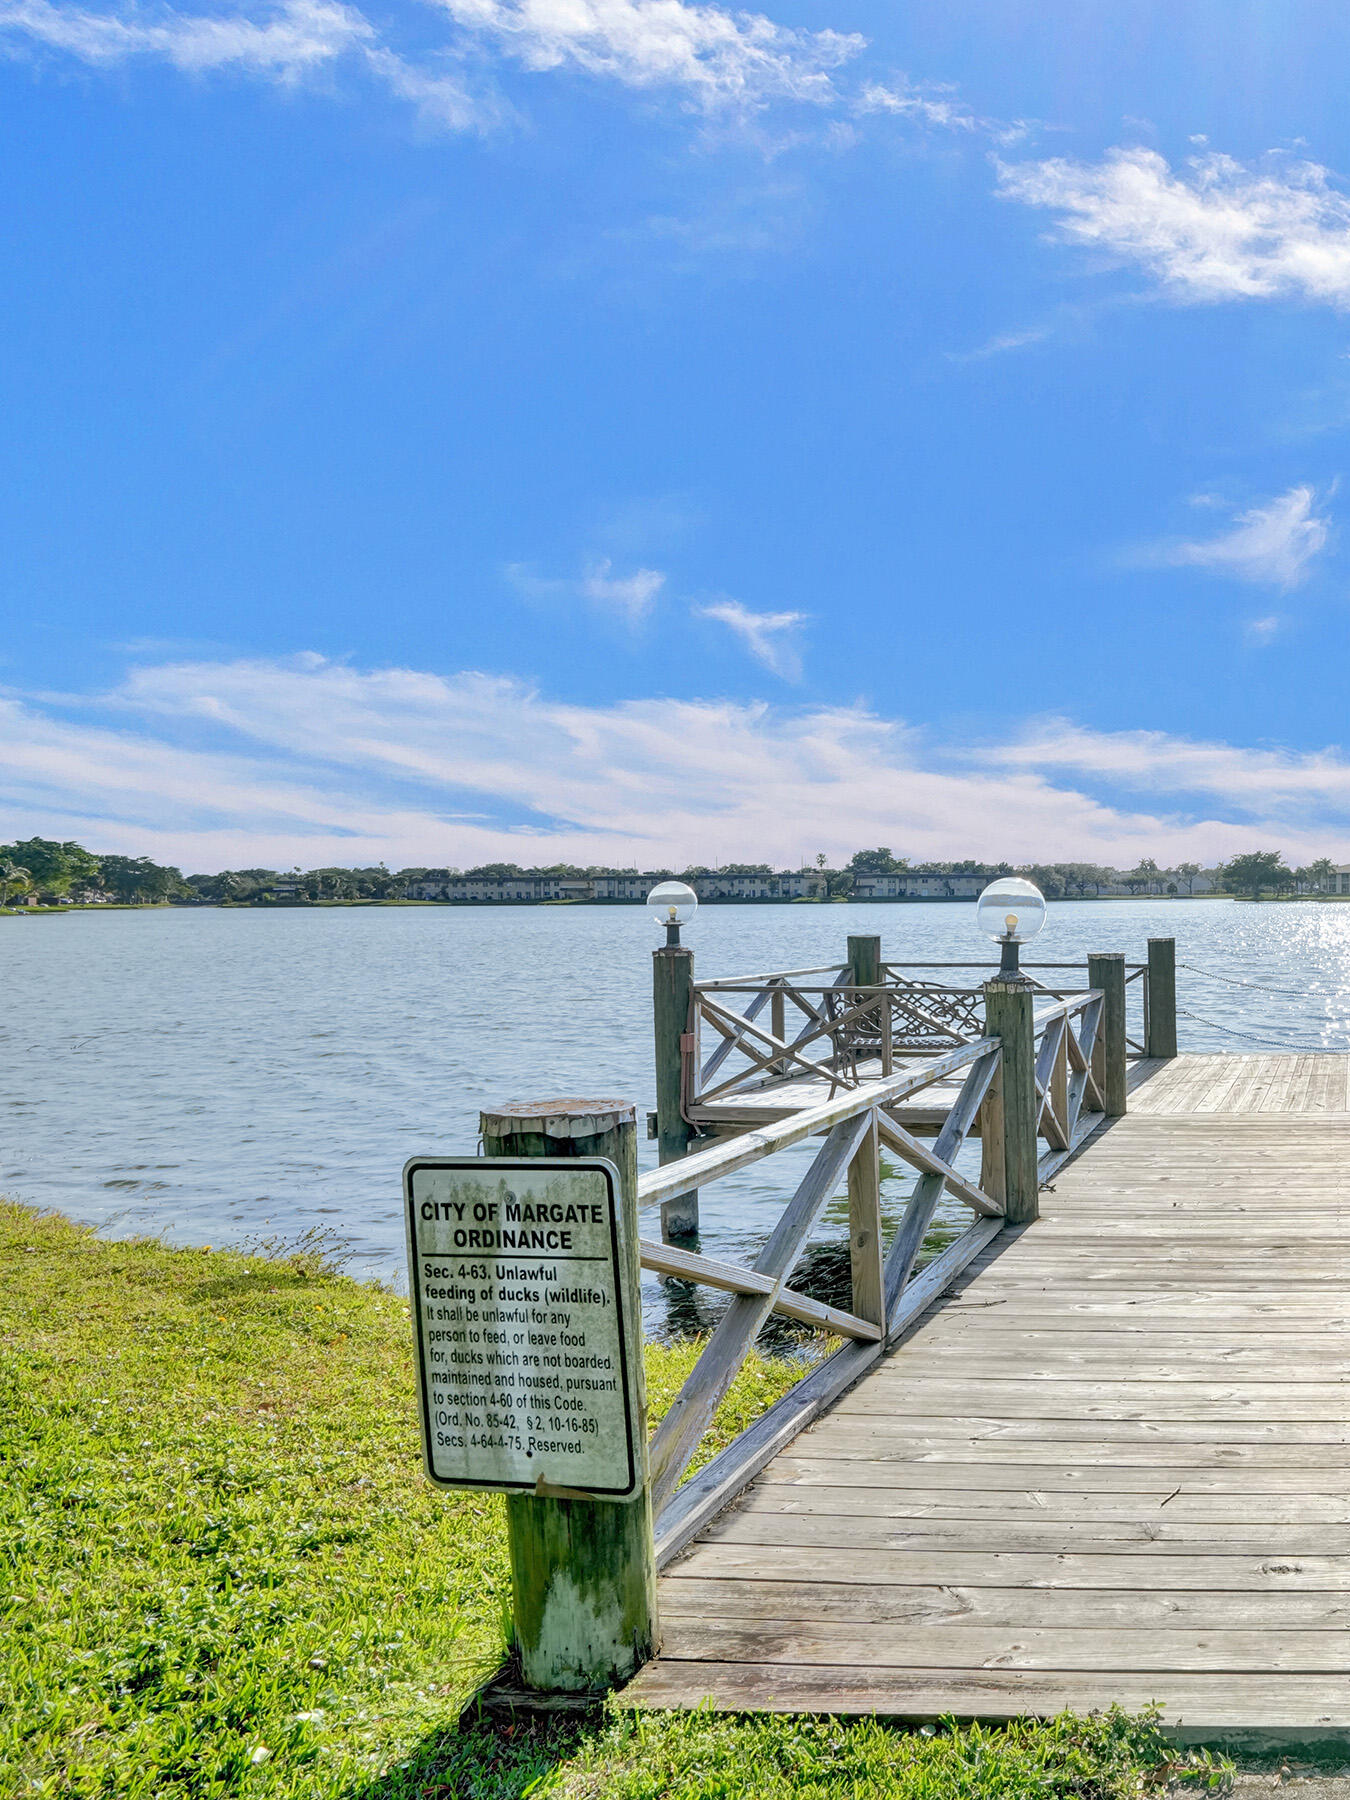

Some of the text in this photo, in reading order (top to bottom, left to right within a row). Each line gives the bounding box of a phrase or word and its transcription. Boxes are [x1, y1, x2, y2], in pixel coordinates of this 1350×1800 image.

[421, 1202, 603, 1223] CITY OF MARGATE
[454, 1229, 572, 1249] ORDINANCE
[424, 1264, 557, 1281] Sec. 4-63. Unlawful
[425, 1286, 610, 1305] feeding of ducks (wildlife).
[427, 1306, 570, 1327] It shall be unlawful for any
[429, 1329, 585, 1346] person to feed, or leave food
[430, 1350, 447, 1365] for,
[451, 1351, 483, 1365] ducks
[487, 1352, 518, 1366] which
[522, 1355, 539, 1366] are
[543, 1354, 561, 1367] not
[432, 1372, 491, 1386] maintained
[495, 1373, 514, 1387] and
[567, 1377, 617, 1392] pursuant
[433, 1392, 586, 1411] to section 4-60 of this Code.
[436, 1412, 462, 1428] (Ord.
[466, 1413, 483, 1427] No.
[549, 1417, 599, 1437] 10-16-85)
[437, 1432, 467, 1447] Secs.
[528, 1437, 584, 1454] Reserved.
